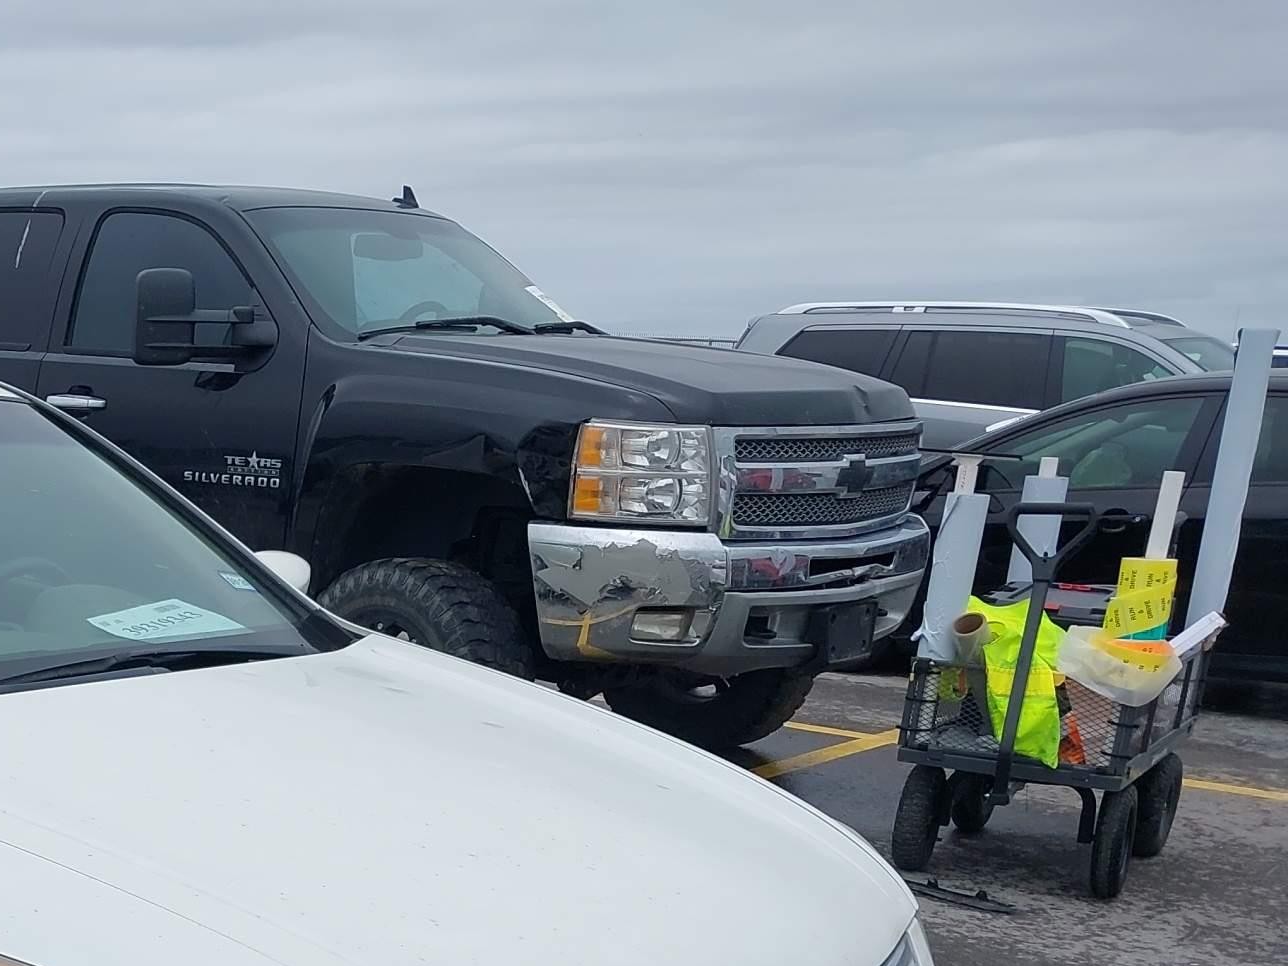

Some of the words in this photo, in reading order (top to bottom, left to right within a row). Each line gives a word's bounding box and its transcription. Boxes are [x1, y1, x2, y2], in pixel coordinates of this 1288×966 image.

[183, 470, 280, 489] SILVERADO
[1129, 569, 1138, 590] DRIVE
[1146, 572, 1154, 588] RUN
[1128, 606, 1137, 622] RUN
[1144, 599, 1154, 620] DRIVE
